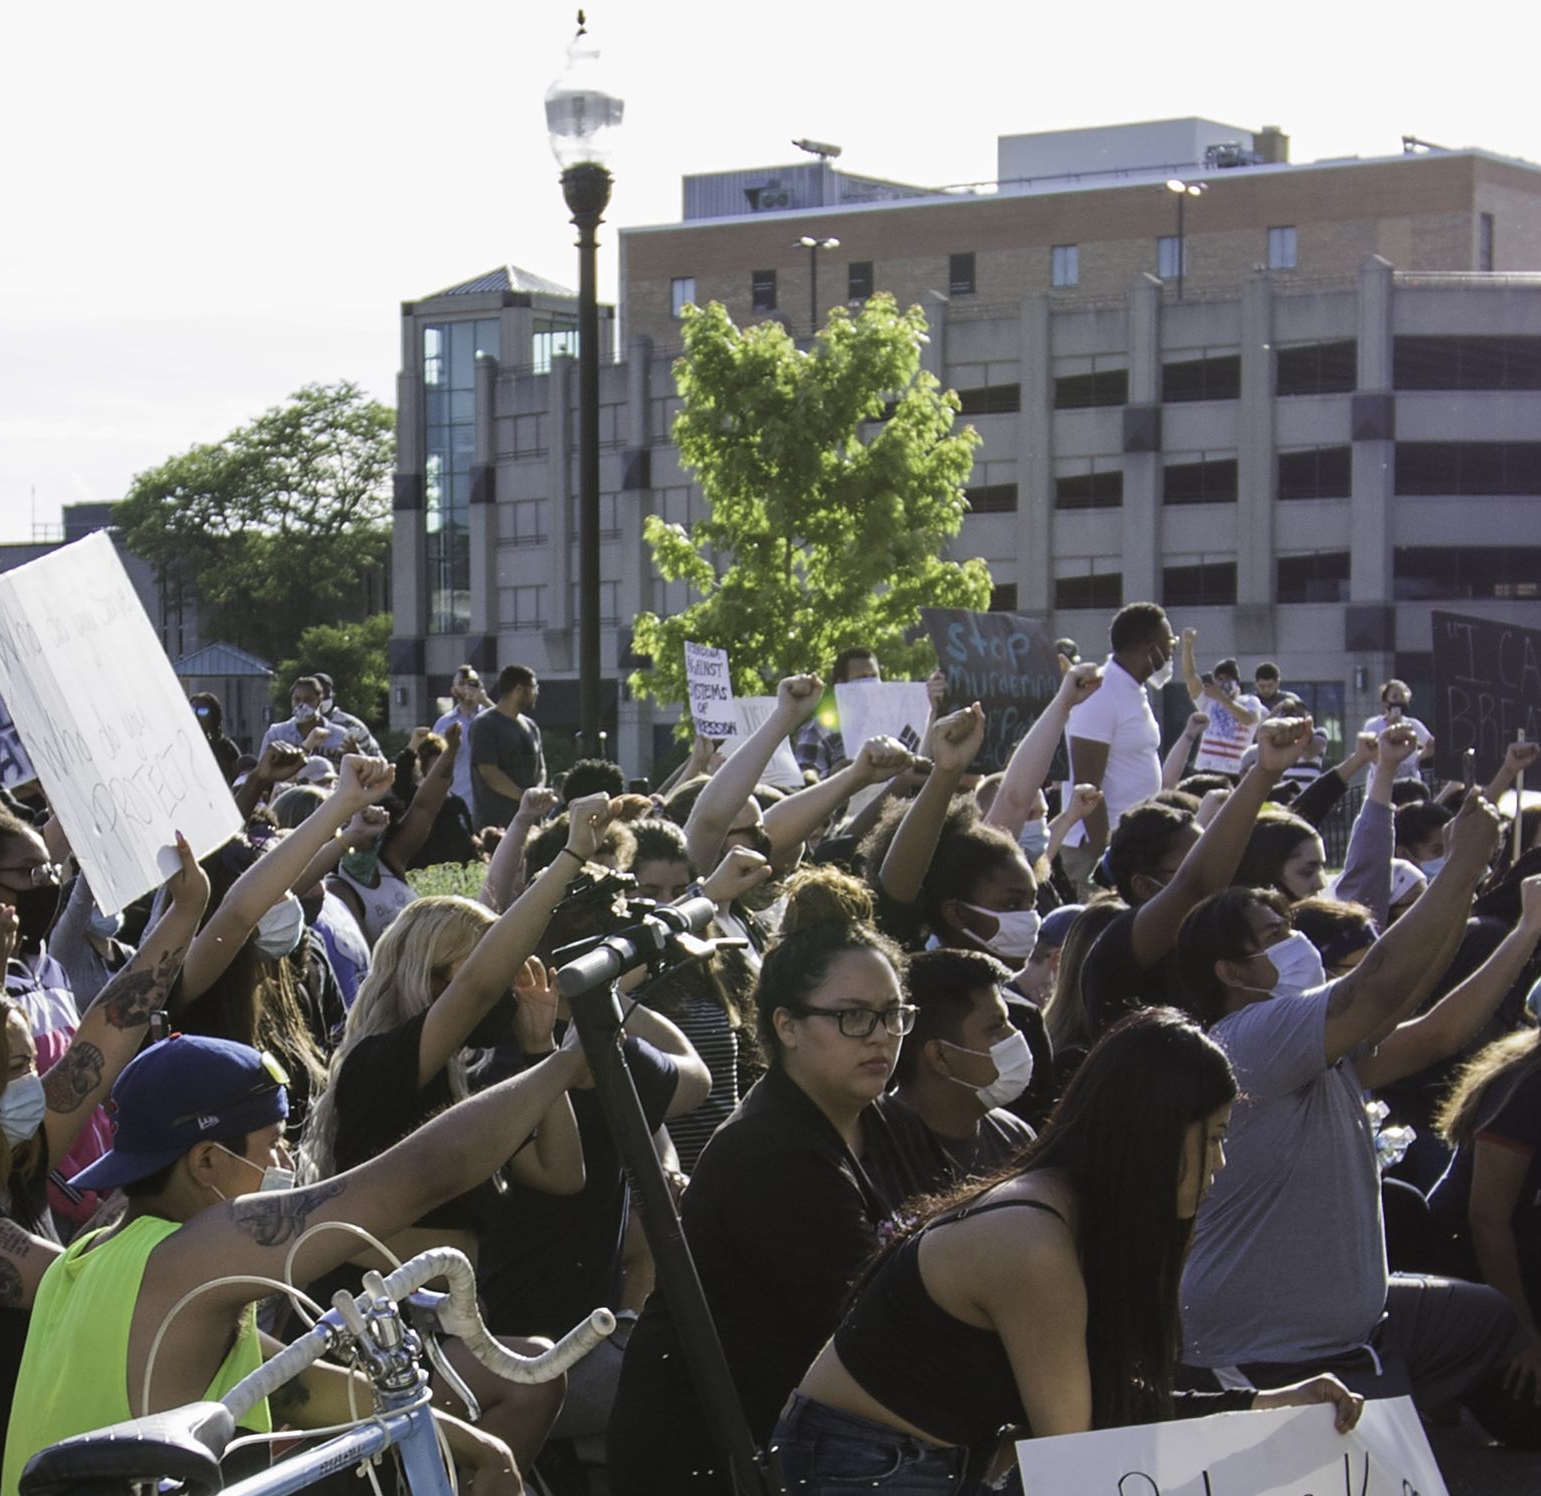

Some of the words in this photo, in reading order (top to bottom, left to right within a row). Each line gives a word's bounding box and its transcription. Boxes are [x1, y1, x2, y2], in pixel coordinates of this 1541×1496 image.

[945, 614, 1031, 672] Stop
[26, 710, 93, 784] Who
[90, 703, 122, 761] do
[88, 728, 214, 836] PROTECT?
